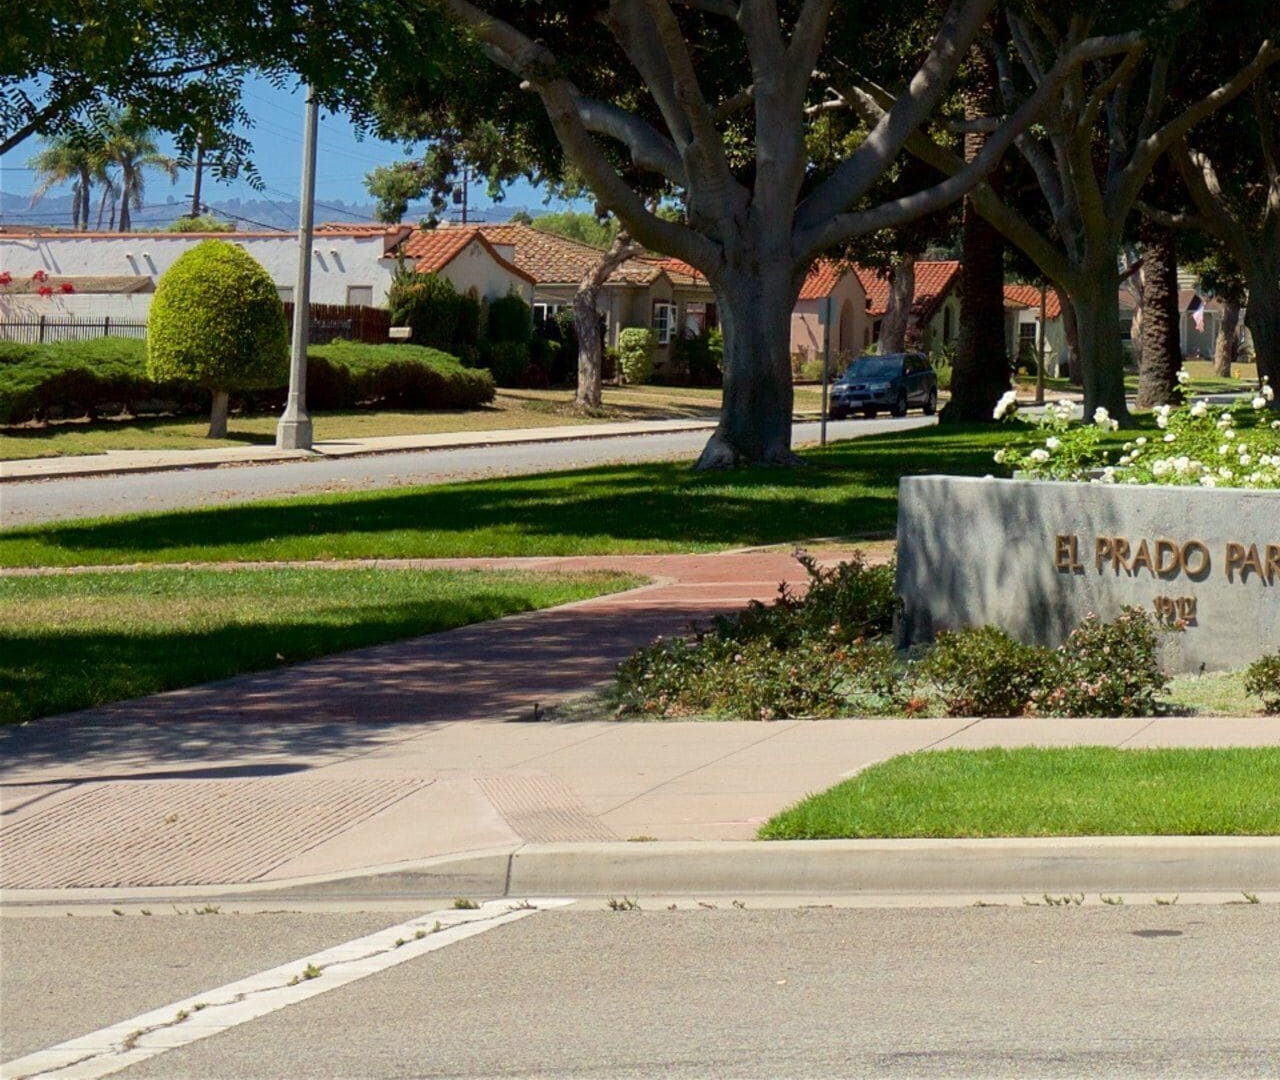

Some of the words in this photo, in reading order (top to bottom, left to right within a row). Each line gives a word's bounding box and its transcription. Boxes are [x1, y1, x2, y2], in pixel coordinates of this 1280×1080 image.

[1055, 534, 1083, 572] EL
[1095, 536, 1210, 577] PRADO
[1153, 595, 1197, 620] 1912
